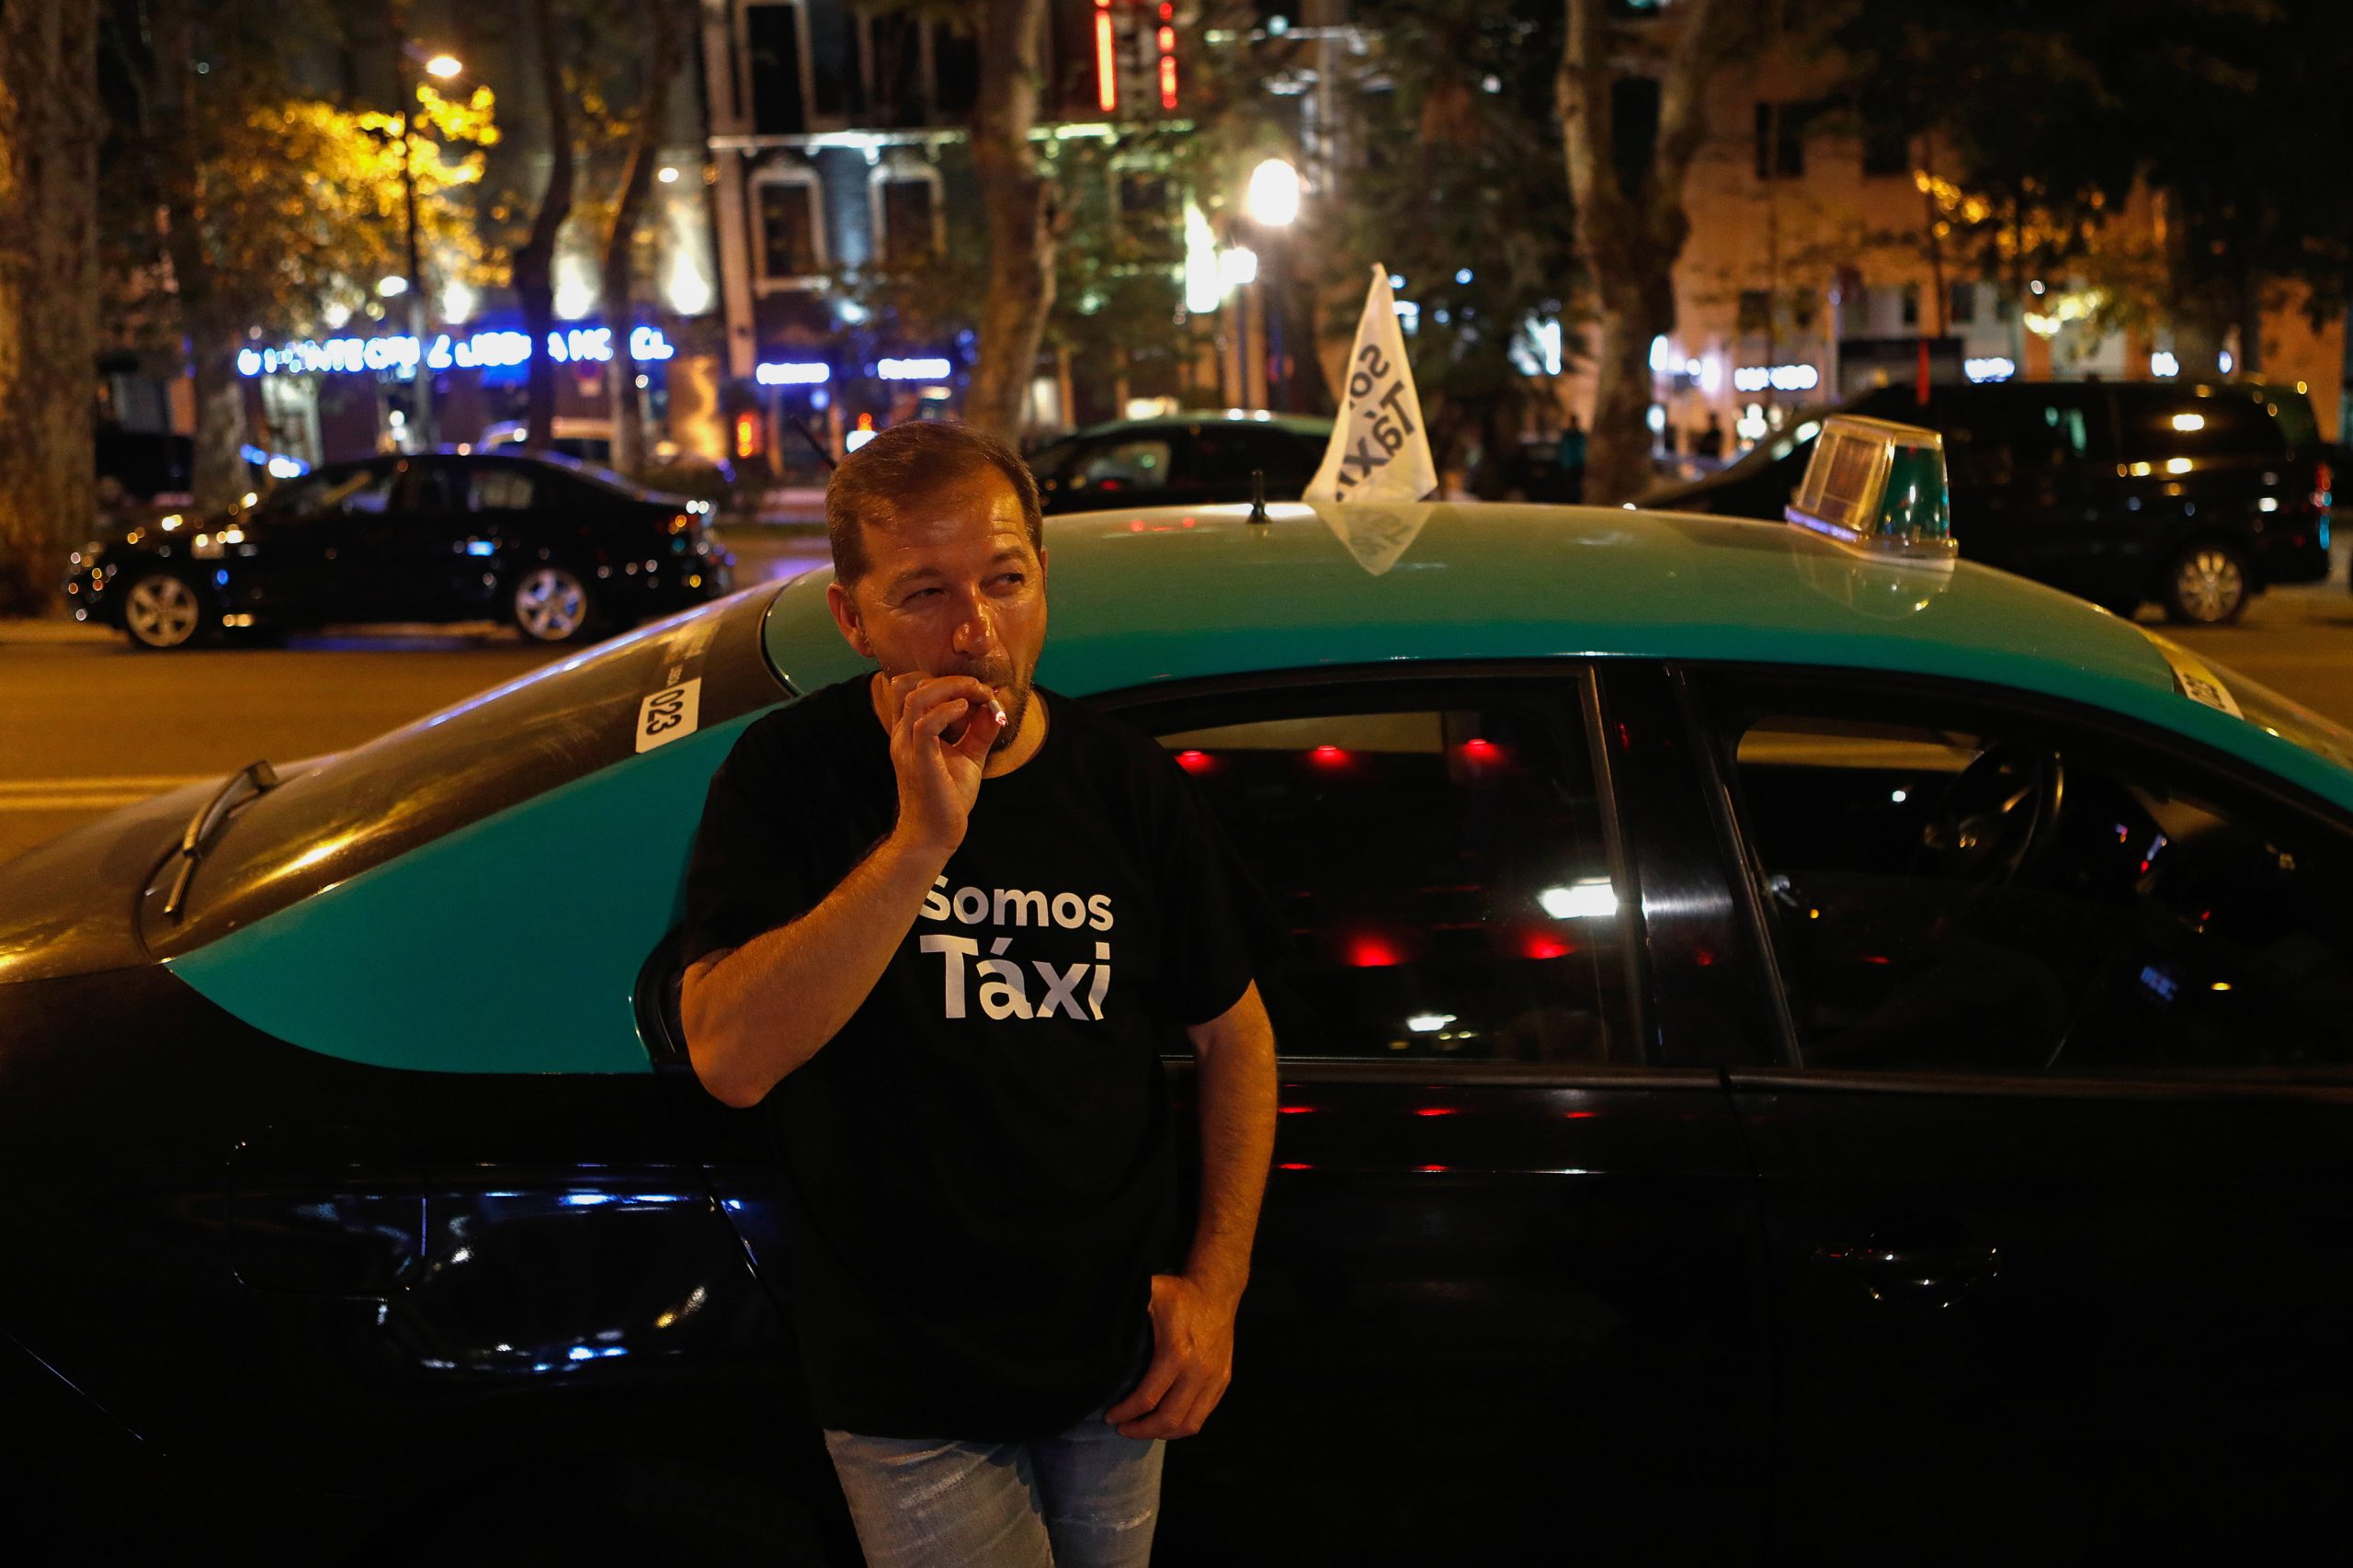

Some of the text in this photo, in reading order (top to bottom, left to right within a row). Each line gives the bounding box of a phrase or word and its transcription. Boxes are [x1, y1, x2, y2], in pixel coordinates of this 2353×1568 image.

[646, 689, 685, 735] 023
[919, 875, 1114, 931] Somos
[920, 934, 1110, 1021] Táxi
